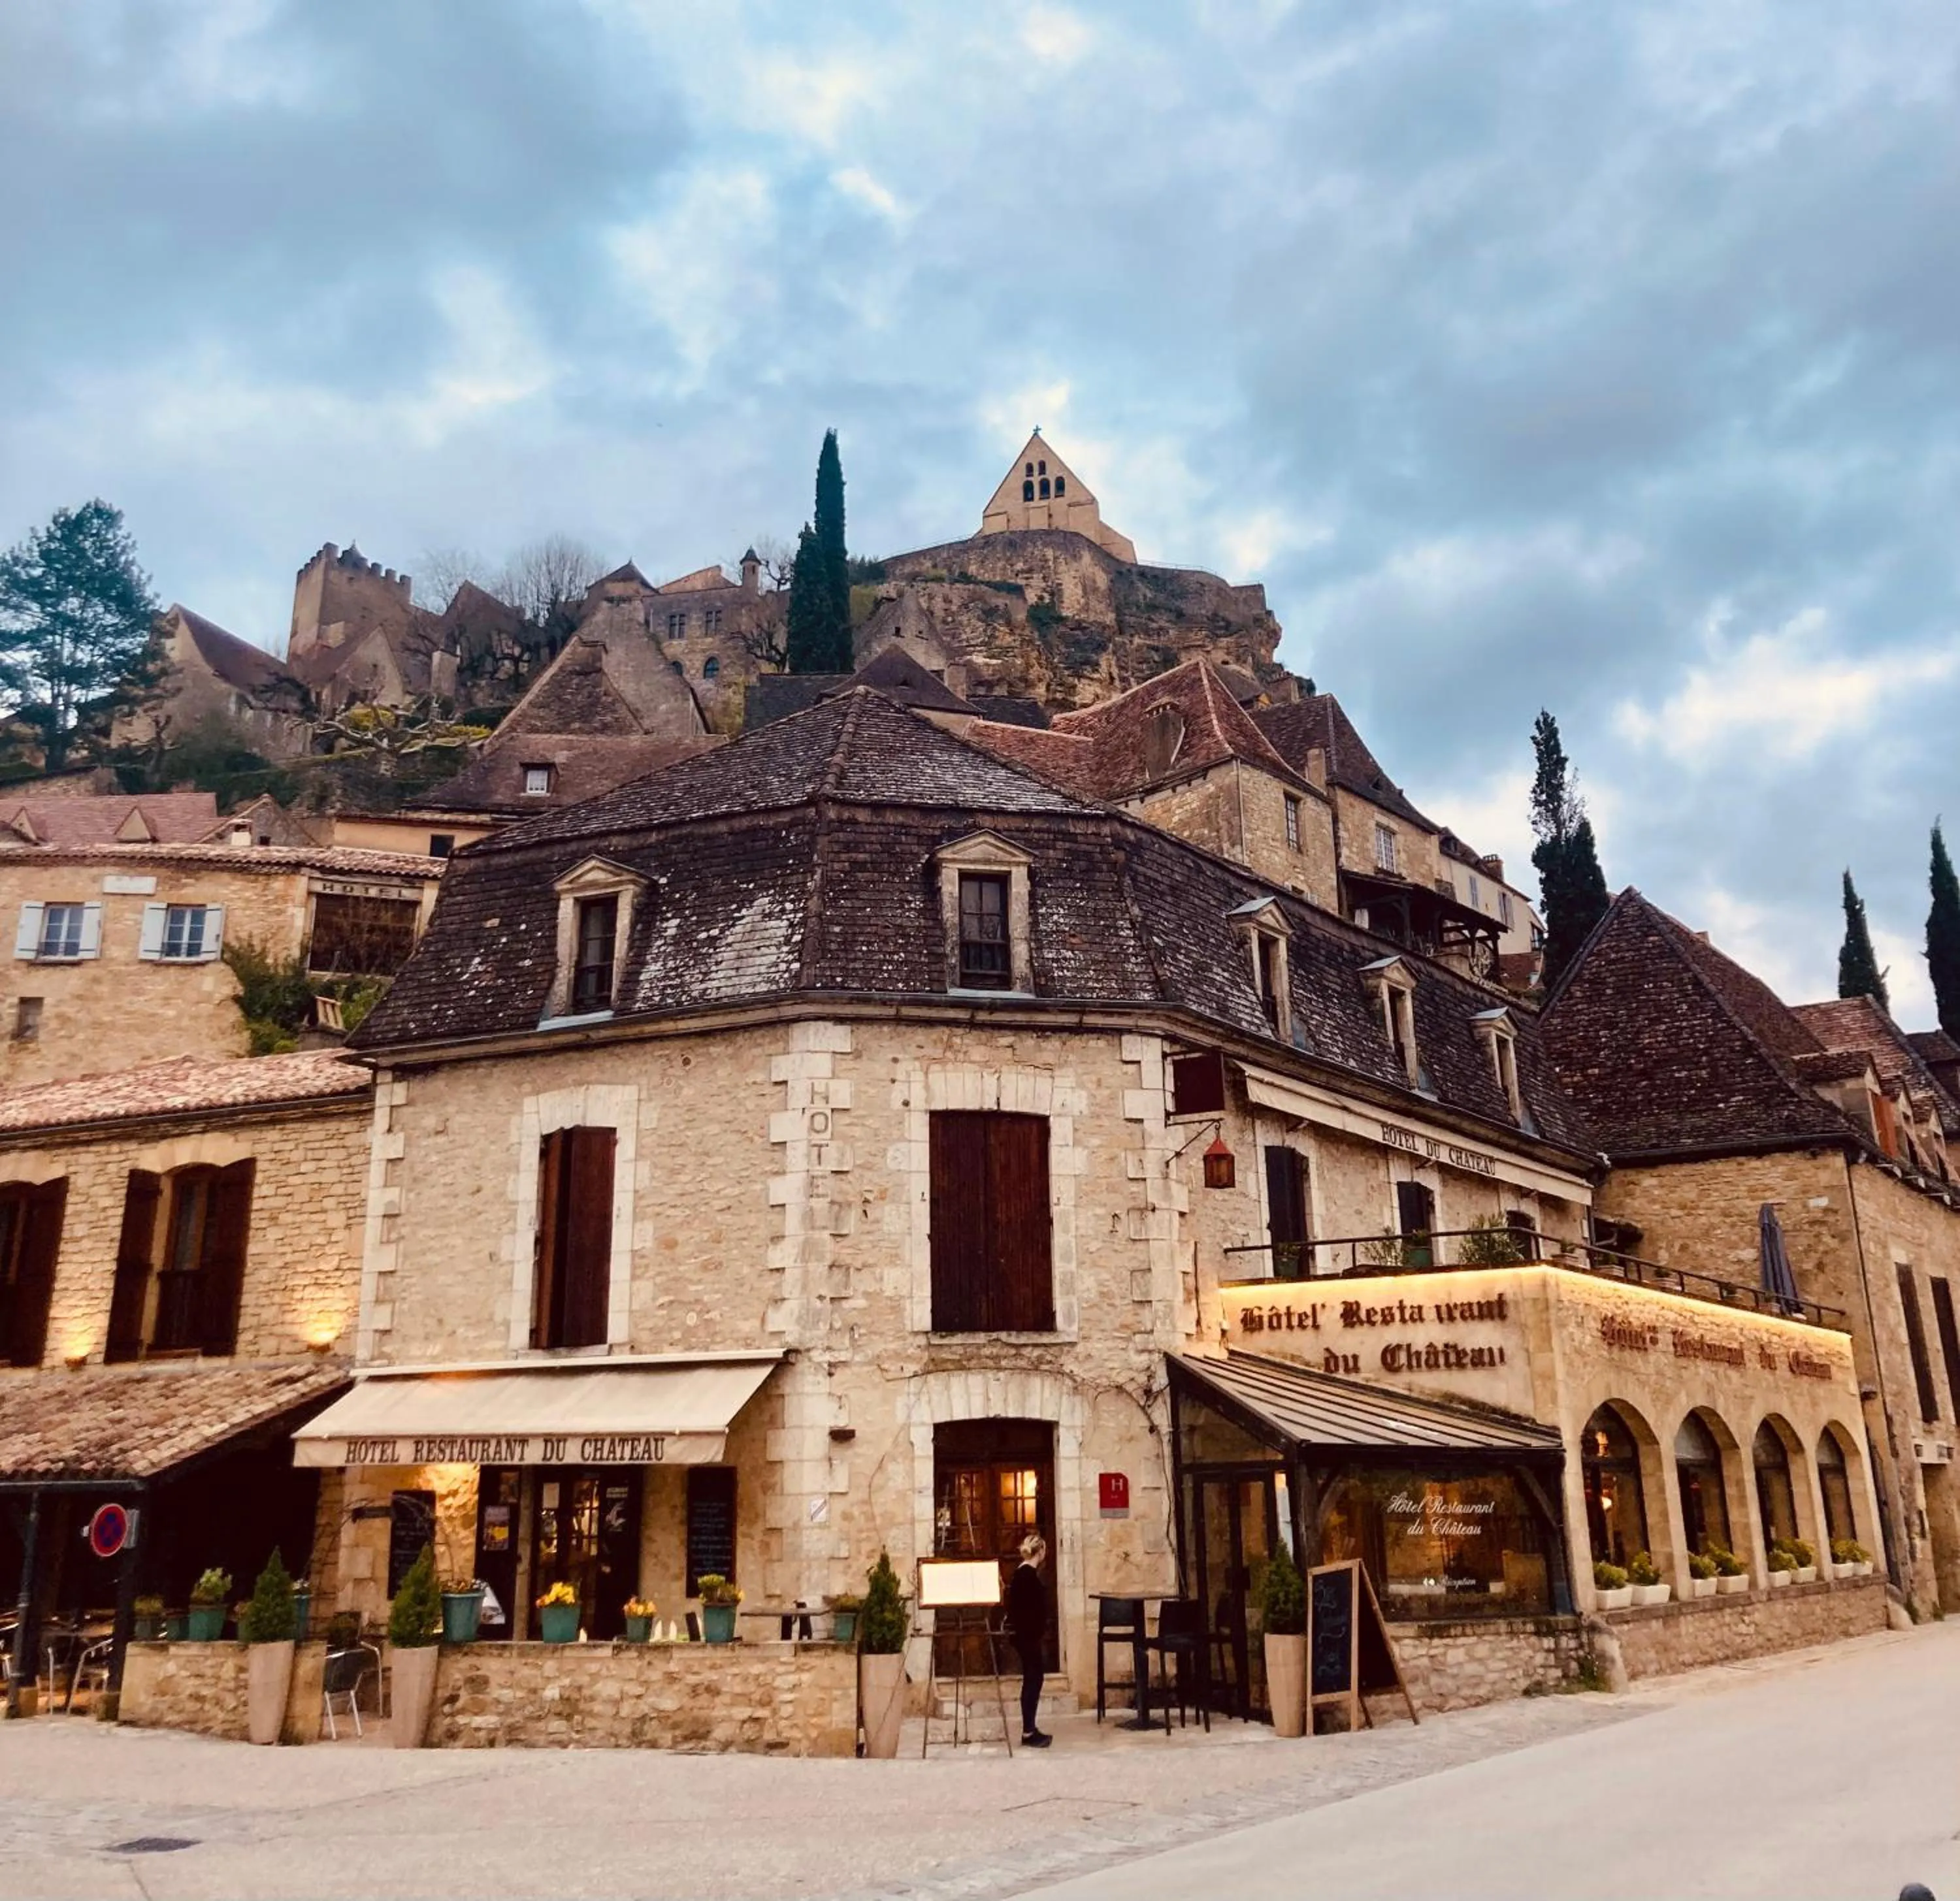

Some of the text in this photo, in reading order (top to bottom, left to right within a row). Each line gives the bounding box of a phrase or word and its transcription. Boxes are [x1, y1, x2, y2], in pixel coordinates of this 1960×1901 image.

[322, 883, 406, 899] HOTEL
[1380, 1122, 1496, 1176] HOTEL DU CHATEAU
[1323, 1346, 1361, 1374] du
[413, 1438, 529, 1463] RESTAURANT
[542, 1438, 567, 1462] DU
[580, 1438, 665, 1461] CHATEAU
[1111, 1478, 1123, 1491] H
[1387, 1491, 1495, 1514] Hôtel Restaurant
[1407, 1517, 1482, 1536] du Château
